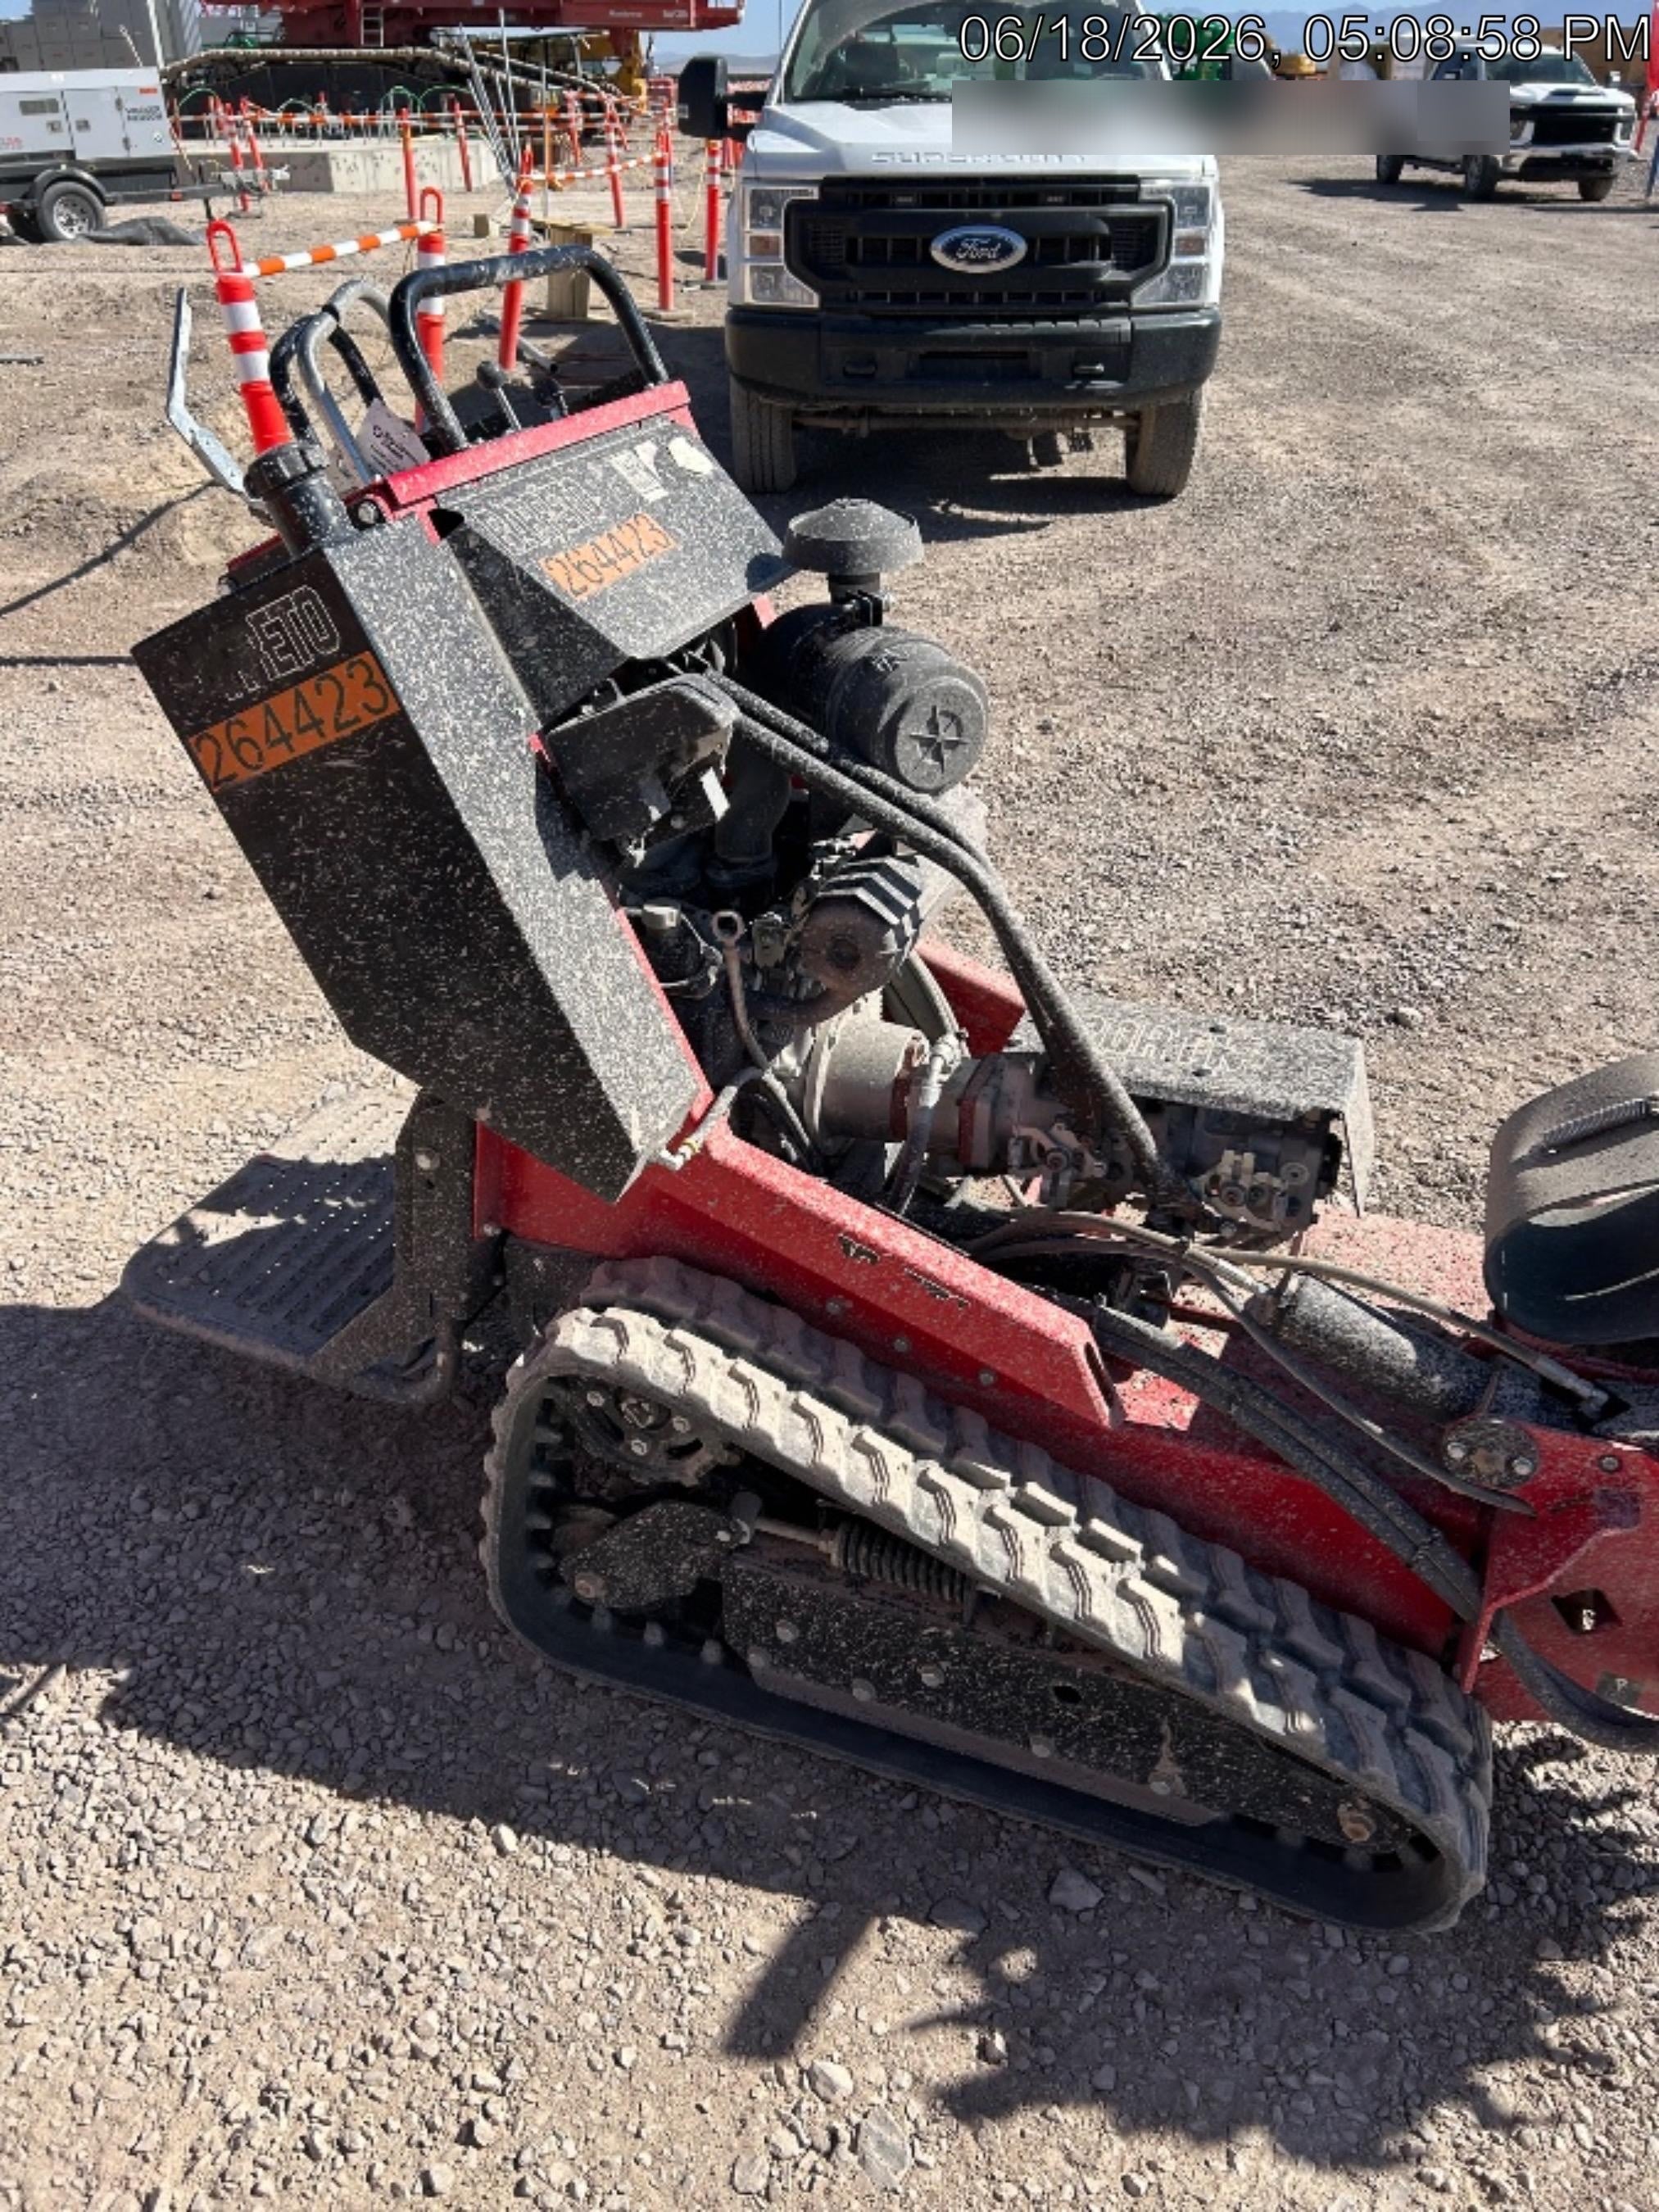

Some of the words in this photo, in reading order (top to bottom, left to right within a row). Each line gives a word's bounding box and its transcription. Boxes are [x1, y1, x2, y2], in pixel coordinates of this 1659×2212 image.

[956, 237, 1001, 260] Ford
[545, 512, 673, 599] 264423
[193, 660, 391, 790] 264423
